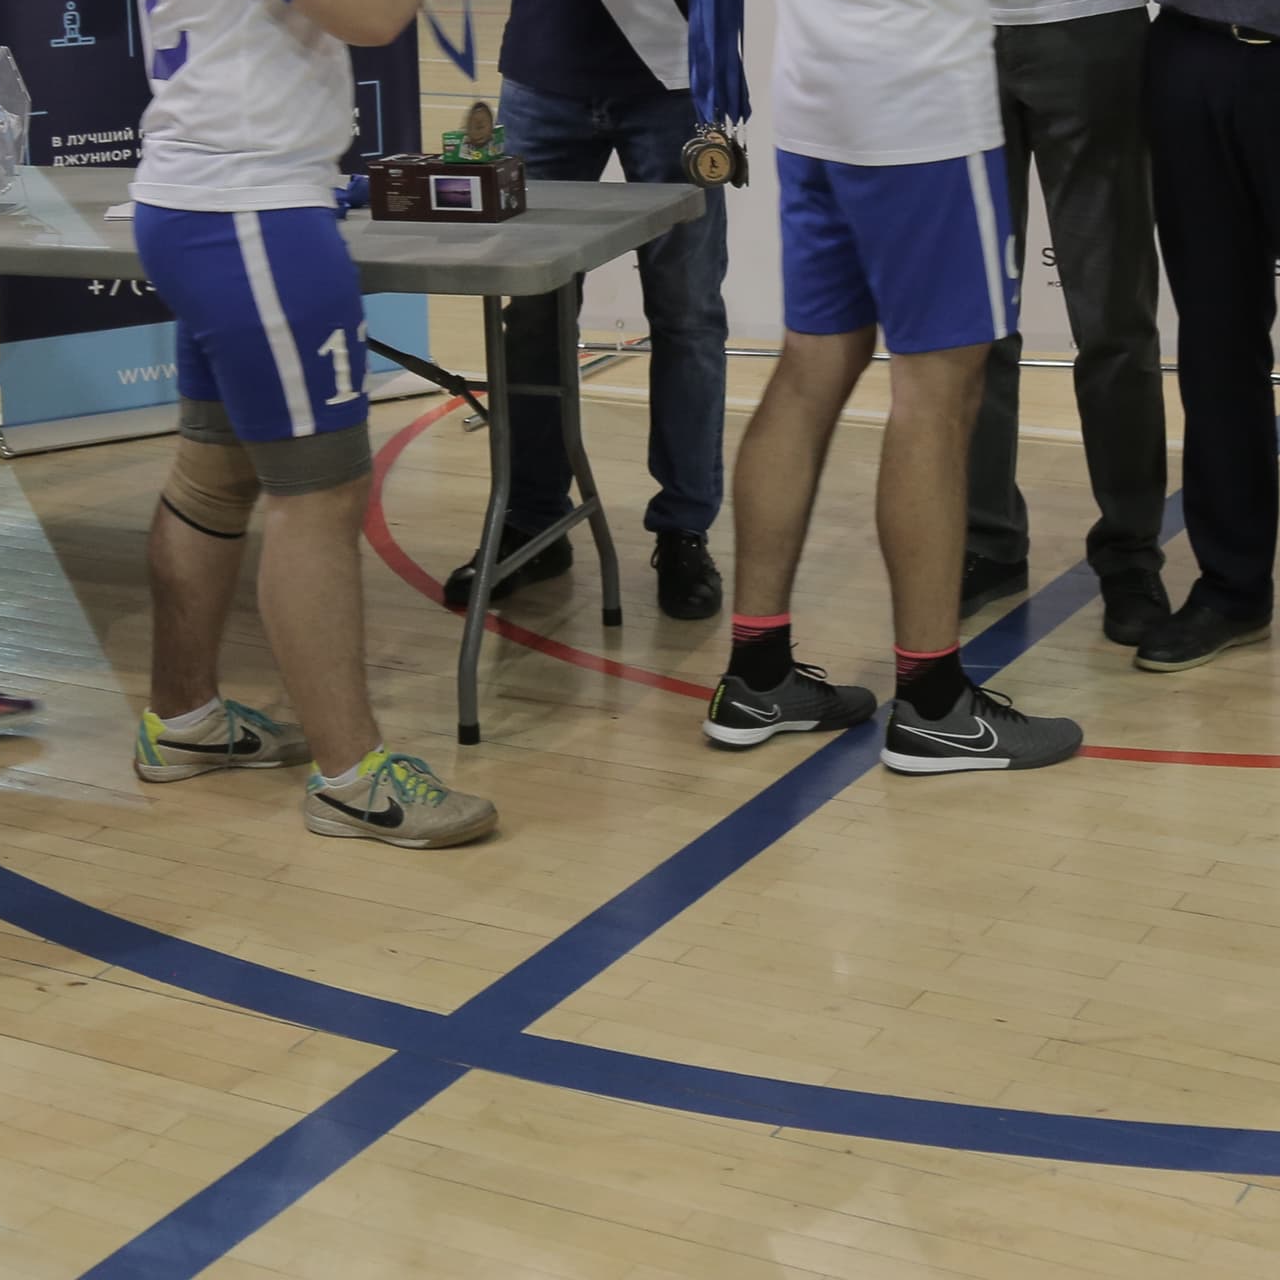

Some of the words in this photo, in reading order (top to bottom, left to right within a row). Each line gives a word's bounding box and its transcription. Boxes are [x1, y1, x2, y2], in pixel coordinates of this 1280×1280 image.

[51, 136, 62, 148] В
[66, 127, 134, 146] ЛУЧШИЙ
[53, 149, 132, 167] ДЖУНИОР
